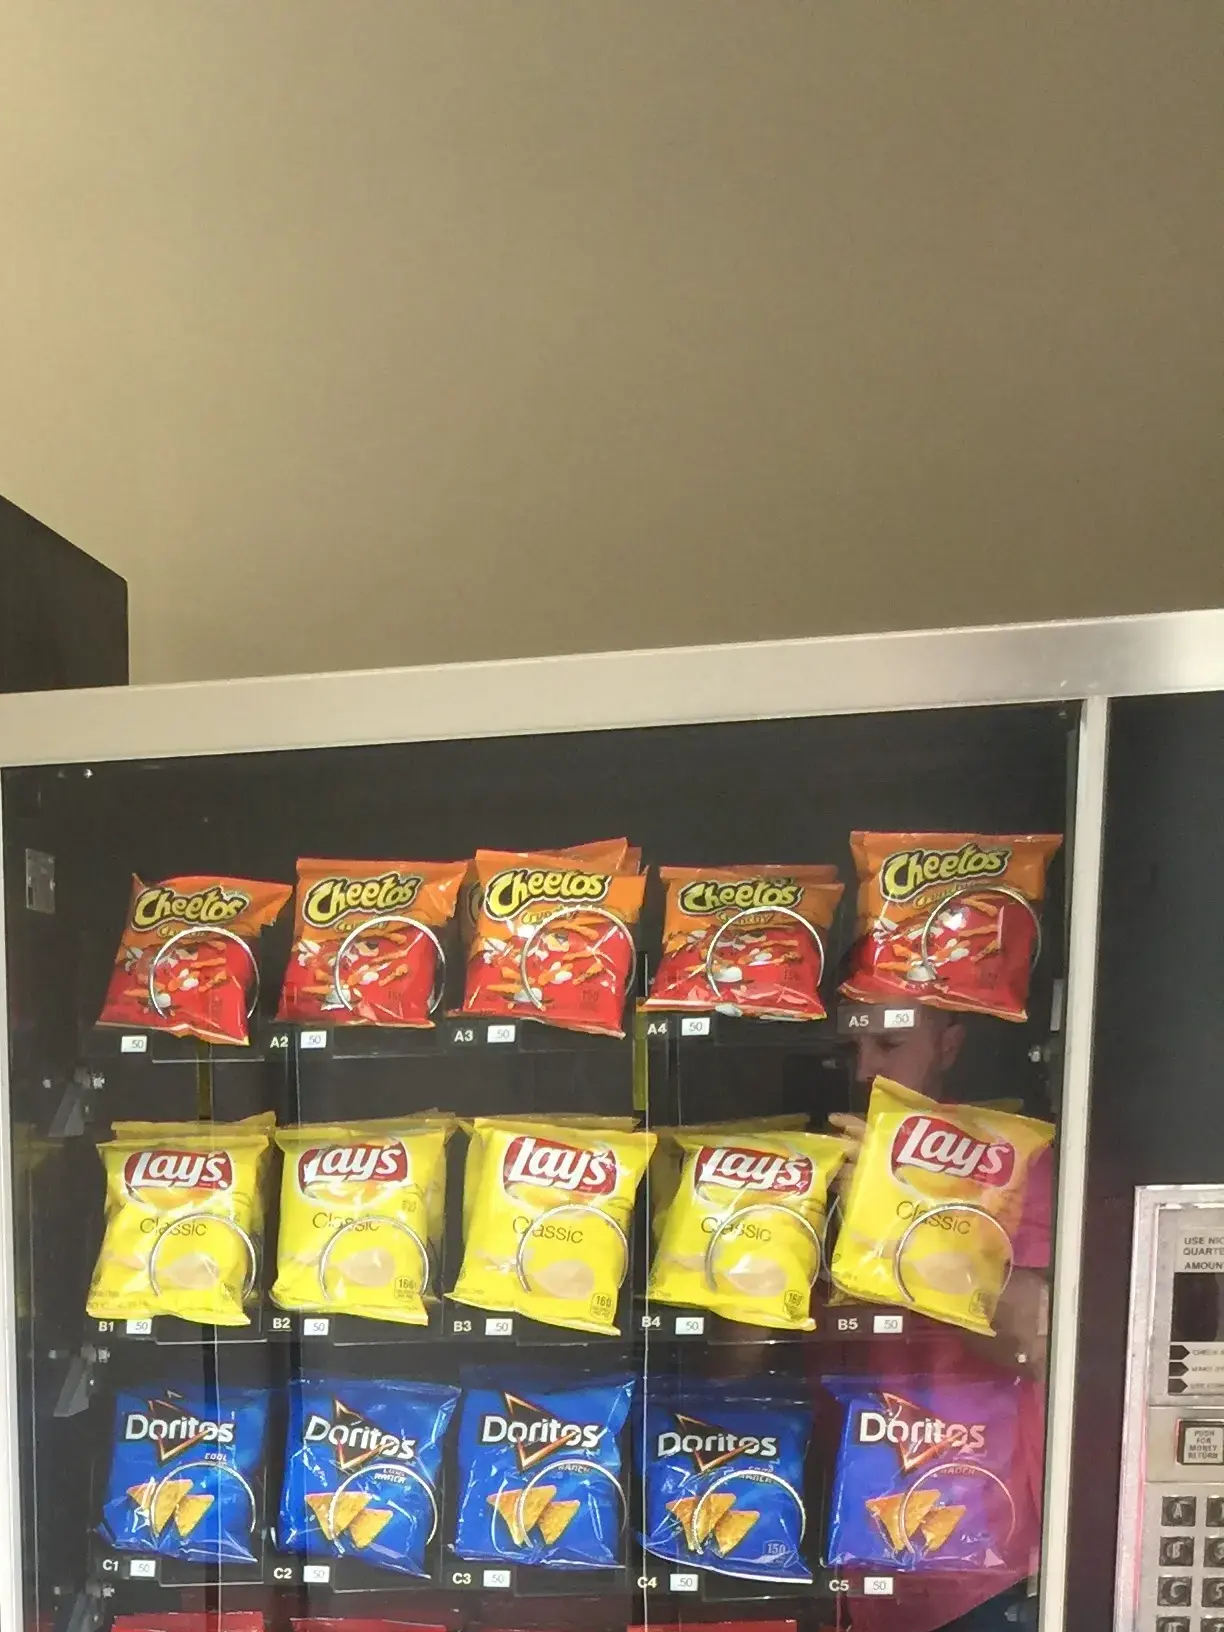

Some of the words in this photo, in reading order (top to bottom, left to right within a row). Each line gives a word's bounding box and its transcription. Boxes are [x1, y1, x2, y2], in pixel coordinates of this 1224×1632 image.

[881, 843, 1009, 900] Cheetos
[306, 872, 420, 924] Cheetos
[486, 870, 608, 918] Cheetos
[680, 880, 802, 914] Cheetos
[133, 886, 247, 930] Cheetos
[848, 1015, 869, 1027] A5
[454, 1029, 473, 1042] A3
[647, 1023, 667, 1035] A4
[270, 1036, 289, 1048] A2
[1184, 1237, 1204, 1245] USE
[98, 1320, 115, 1332] B1
[272, 1317, 291, 1329] B2
[453, 1320, 472, 1332] B3
[641, 1315, 661, 1328] B4
[837, 1318, 859, 1331] B5
[125, 1413, 235, 1443] Doritos
[482, 1415, 600, 1448] Doritos
[859, 1412, 987, 1449] Doritos
[304, 1415, 416, 1460] Doritos
[657, 1431, 777, 1458] Doritos
[102, 1559, 119, 1572] C1
[273, 1567, 293, 1579] C2
[452, 1572, 471, 1585] C3
[637, 1576, 657, 1589] C4
[829, 1579, 849, 1592] C5
